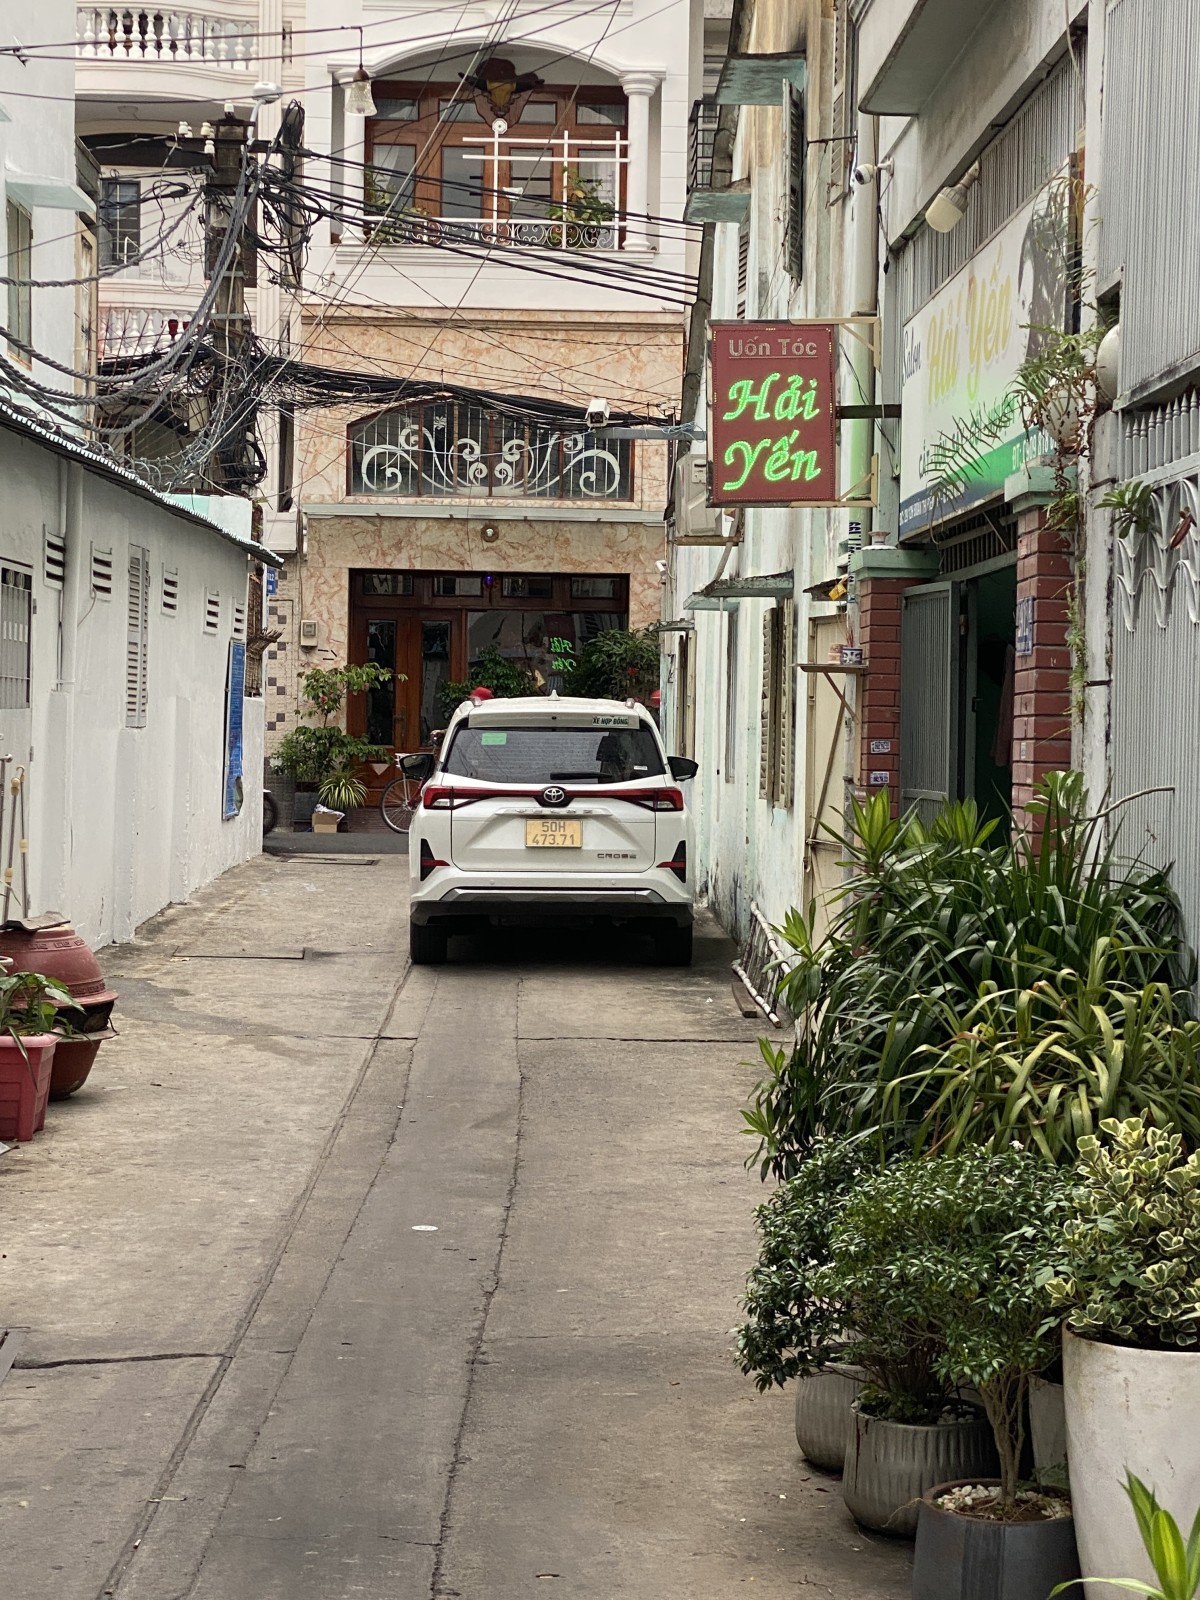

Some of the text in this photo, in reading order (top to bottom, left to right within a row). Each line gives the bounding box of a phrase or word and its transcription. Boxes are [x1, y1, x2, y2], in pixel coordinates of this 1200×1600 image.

[966, 243, 1011, 402] Yến
[729, 336, 818, 356] Uốn Tóc
[723, 372, 820, 420] Hải
[723, 430, 821, 490] Yến
[593, 717, 600, 725] XE
[541, 821, 567, 833] 50H
[532, 834, 576, 846] 473.71
